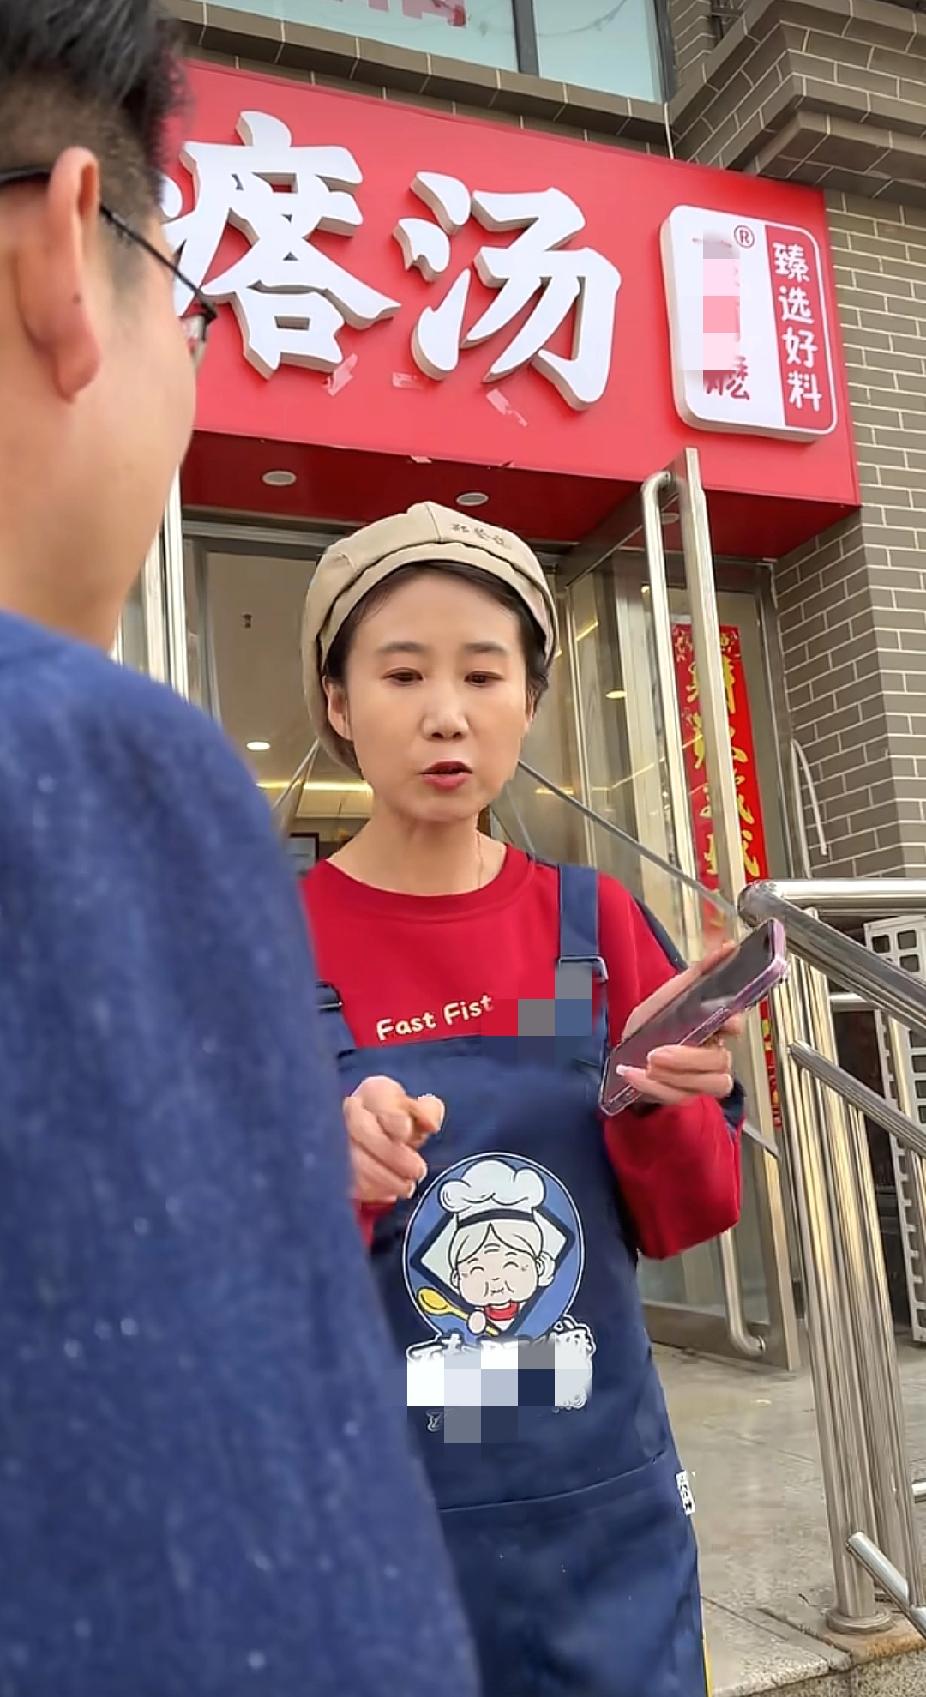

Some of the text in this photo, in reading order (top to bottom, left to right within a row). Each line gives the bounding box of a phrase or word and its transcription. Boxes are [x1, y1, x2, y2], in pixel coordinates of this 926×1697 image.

[773, 242, 822, 411] 臻选好料
[376, 995, 494, 1041] Fast Fist
